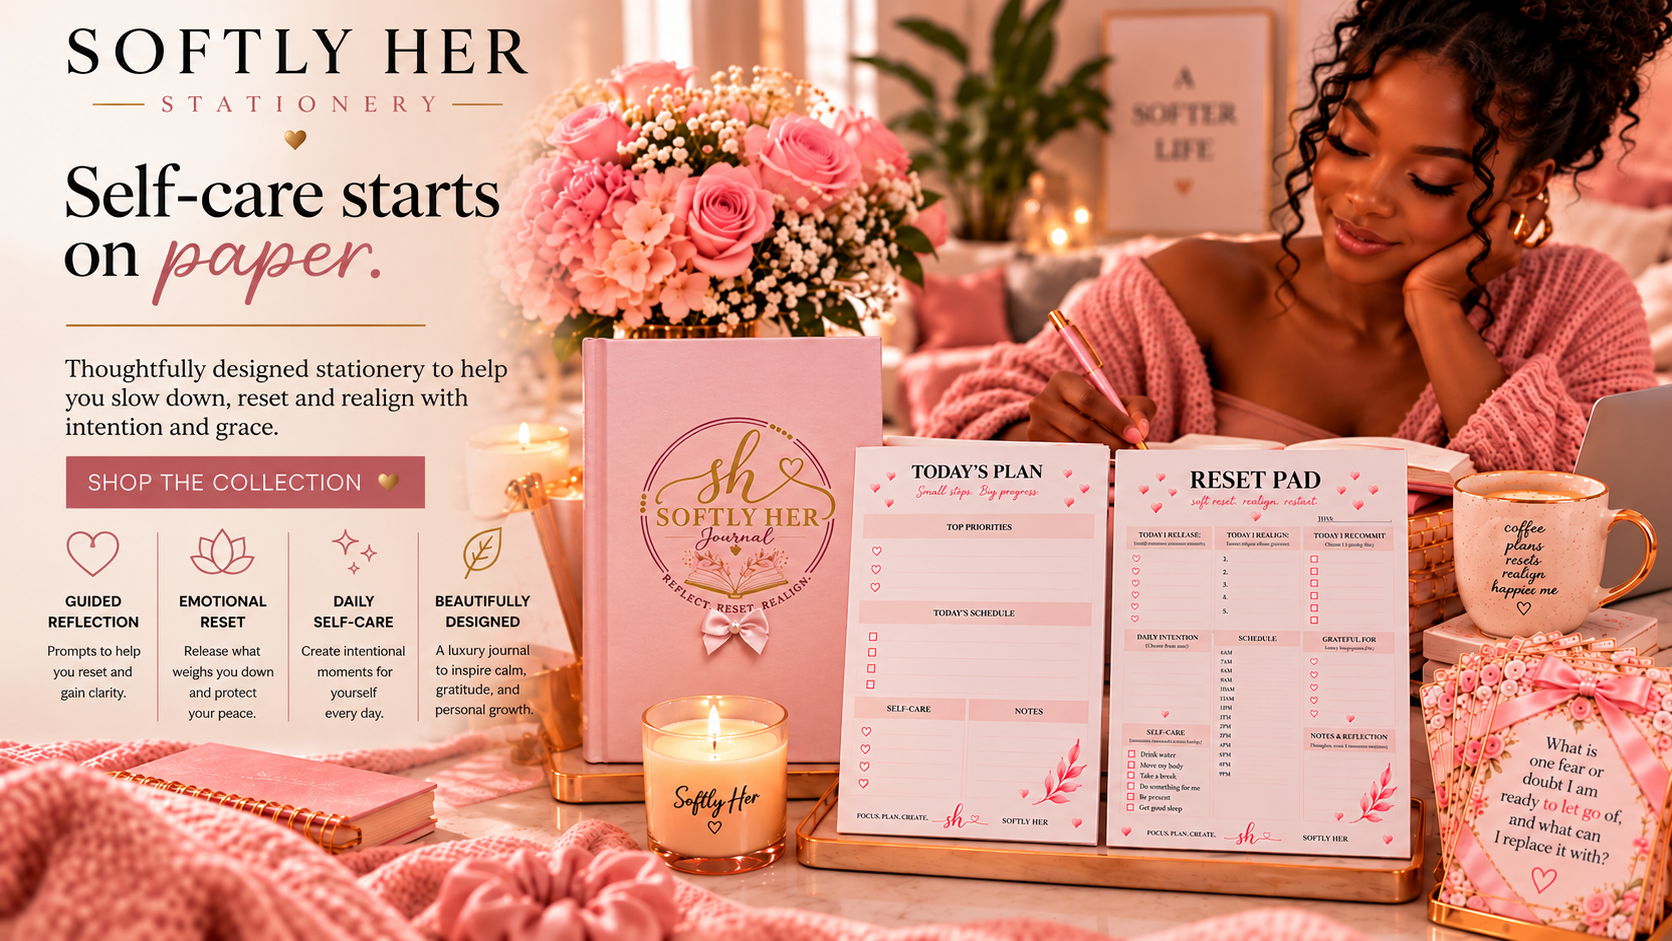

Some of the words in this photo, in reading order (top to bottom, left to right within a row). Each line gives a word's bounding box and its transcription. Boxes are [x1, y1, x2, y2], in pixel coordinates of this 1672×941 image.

[1174, 65, 1195, 90] A
[1131, 101, 1237, 126] SOFTER
[1155, 138, 1215, 162] LIFE
[911, 464, 989, 480] TODAY'S
[993, 464, 1043, 479] PLAN
[1190, 470, 1267, 490] RESET
[1272, 470, 1321, 490] PAD
[915, 484, 948, 499] Small
[656, 507, 760, 528] SOFTLY
[764, 507, 821, 527] HER
[946, 523, 965, 531] TOP
[965, 523, 1013, 531] PRIORITIES
[1138, 531, 1163, 539] TODAY
[1226, 531, 1252, 539] TODAY
[1313, 532, 1339, 540] TODAY
[1344, 532, 1387, 540] RECOMMIT
[1504, 520, 1547, 542] coffee
[695, 526, 776, 551] Journal
[1504, 538, 1545, 556] plans
[1502, 566, 1546, 585] realign
[662, 573, 712, 611] REFLECT.
[761, 576, 812, 610] REALIGN.
[1539, 587, 1559, 595] me
[970, 609, 1016, 618] SCHEDULE
[1136, 633, 1159, 641] DAILY
[1159, 634, 1199, 642] INTENTION
[886, 704, 932, 713] SELF-CARE
[1014, 707, 1044, 716] NOTES
[1146, 728, 1186, 736] SELF-CARE
[1310, 732, 1335, 740] NOTES
[1342, 733, 1389, 741] REFLECTION
[1140, 750, 1158, 758] Drink
[1546, 736, 1583, 755] What
[1586, 744, 1598, 758] is
[1529, 757, 1555, 769] one
[1558, 758, 1586, 775] fear
[1588, 767, 1604, 778] or
[1522, 772, 1563, 791] doubt
[1566, 779, 1573, 793] I
[1575, 786, 1598, 798] am
[673, 785, 726, 818] Softly
[728, 784, 760, 814] Her
[1500, 792, 1540, 811] ready
[1543, 798, 1558, 811] to
[1561, 799, 1579, 816] let
[1581, 807, 1601, 821] go
[1604, 809, 1623, 826] of,
[1002, 817, 1031, 825] SOFTLY
[1032, 818, 1049, 826] HER
[1508, 815, 1536, 829] and
[1538, 819, 1572, 837] what
[1575, 828, 1601, 843] can
[1302, 834, 1331, 842] SOFTLY
[1332, 835, 1349, 843] HER
[1494, 830, 1501, 843] I
[1503, 836, 1553, 854] replace
[1556, 843, 1567, 857] it
[1570, 848, 1610, 865] with?
